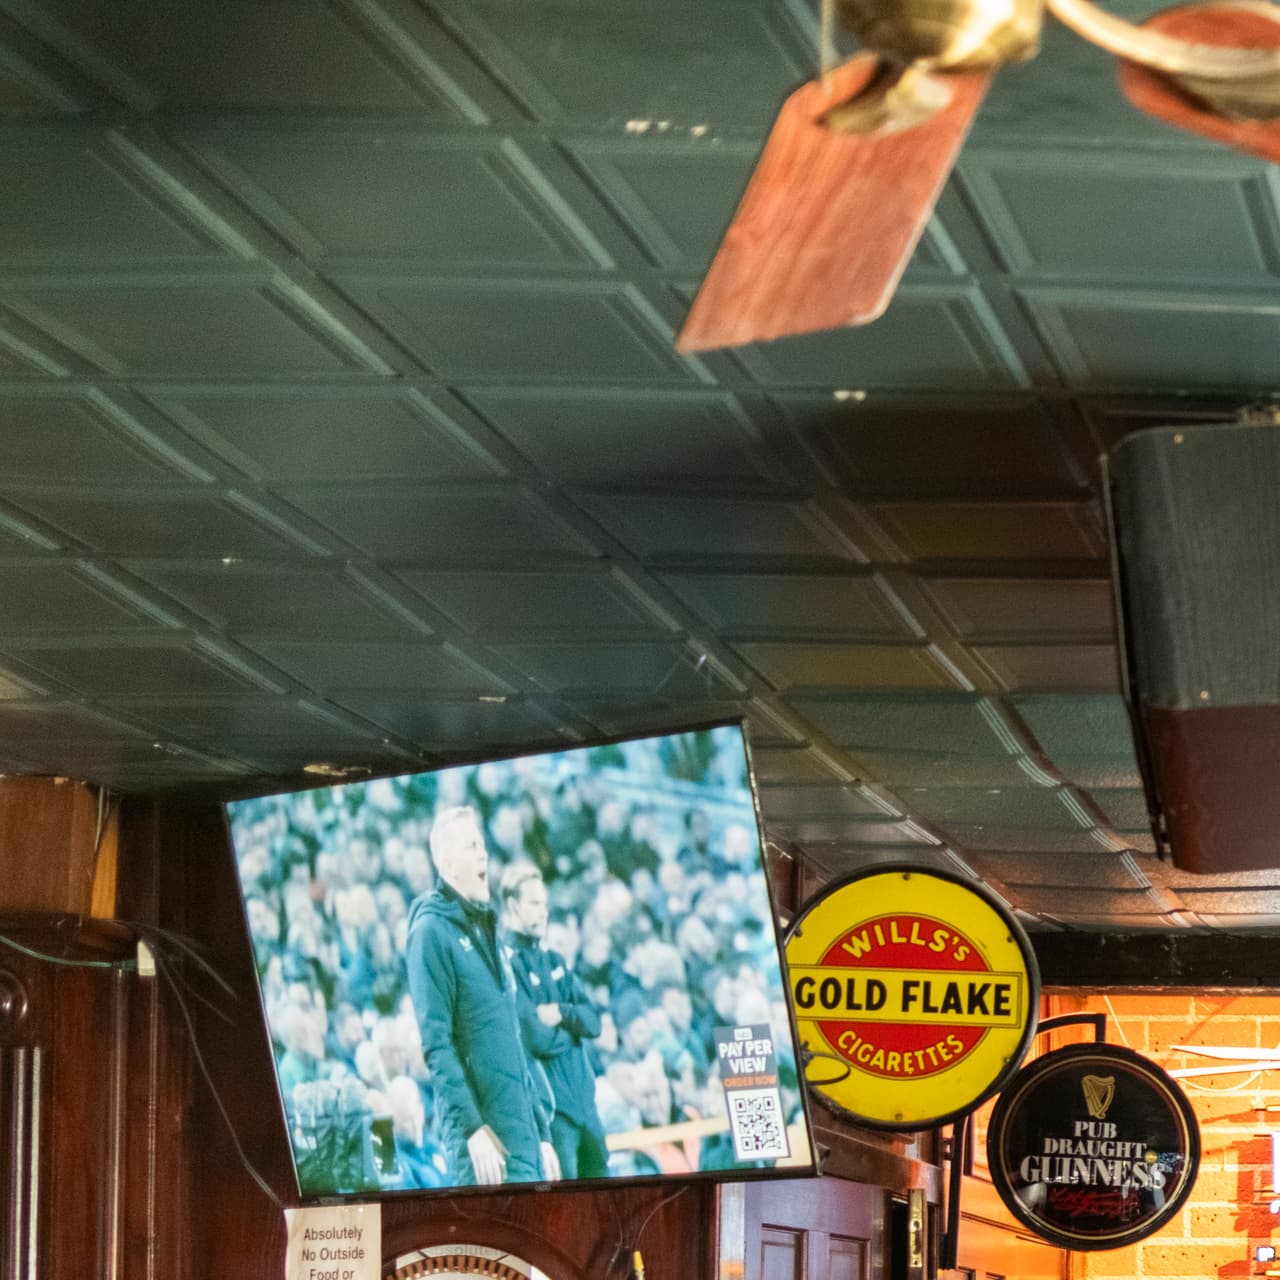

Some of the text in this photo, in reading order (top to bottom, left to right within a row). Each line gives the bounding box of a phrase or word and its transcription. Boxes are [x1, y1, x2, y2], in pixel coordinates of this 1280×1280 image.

[795, 975, 1012, 1017] GOLD FLAKE
[718, 1039, 773, 1058] PAY PER
[837, 1029, 965, 1073] CIGARETTES
[728, 1056, 767, 1074] VIEW
[1074, 1120, 1118, 1139] PUB
[1043, 1137, 1148, 1159] DRAUGHT
[1020, 1155, 1166, 1190] GUINNESS
[303, 1226, 363, 1241] Absolutely
[301, 1247, 365, 1262] No Outside
[342, 1269, 355, 1280] or
